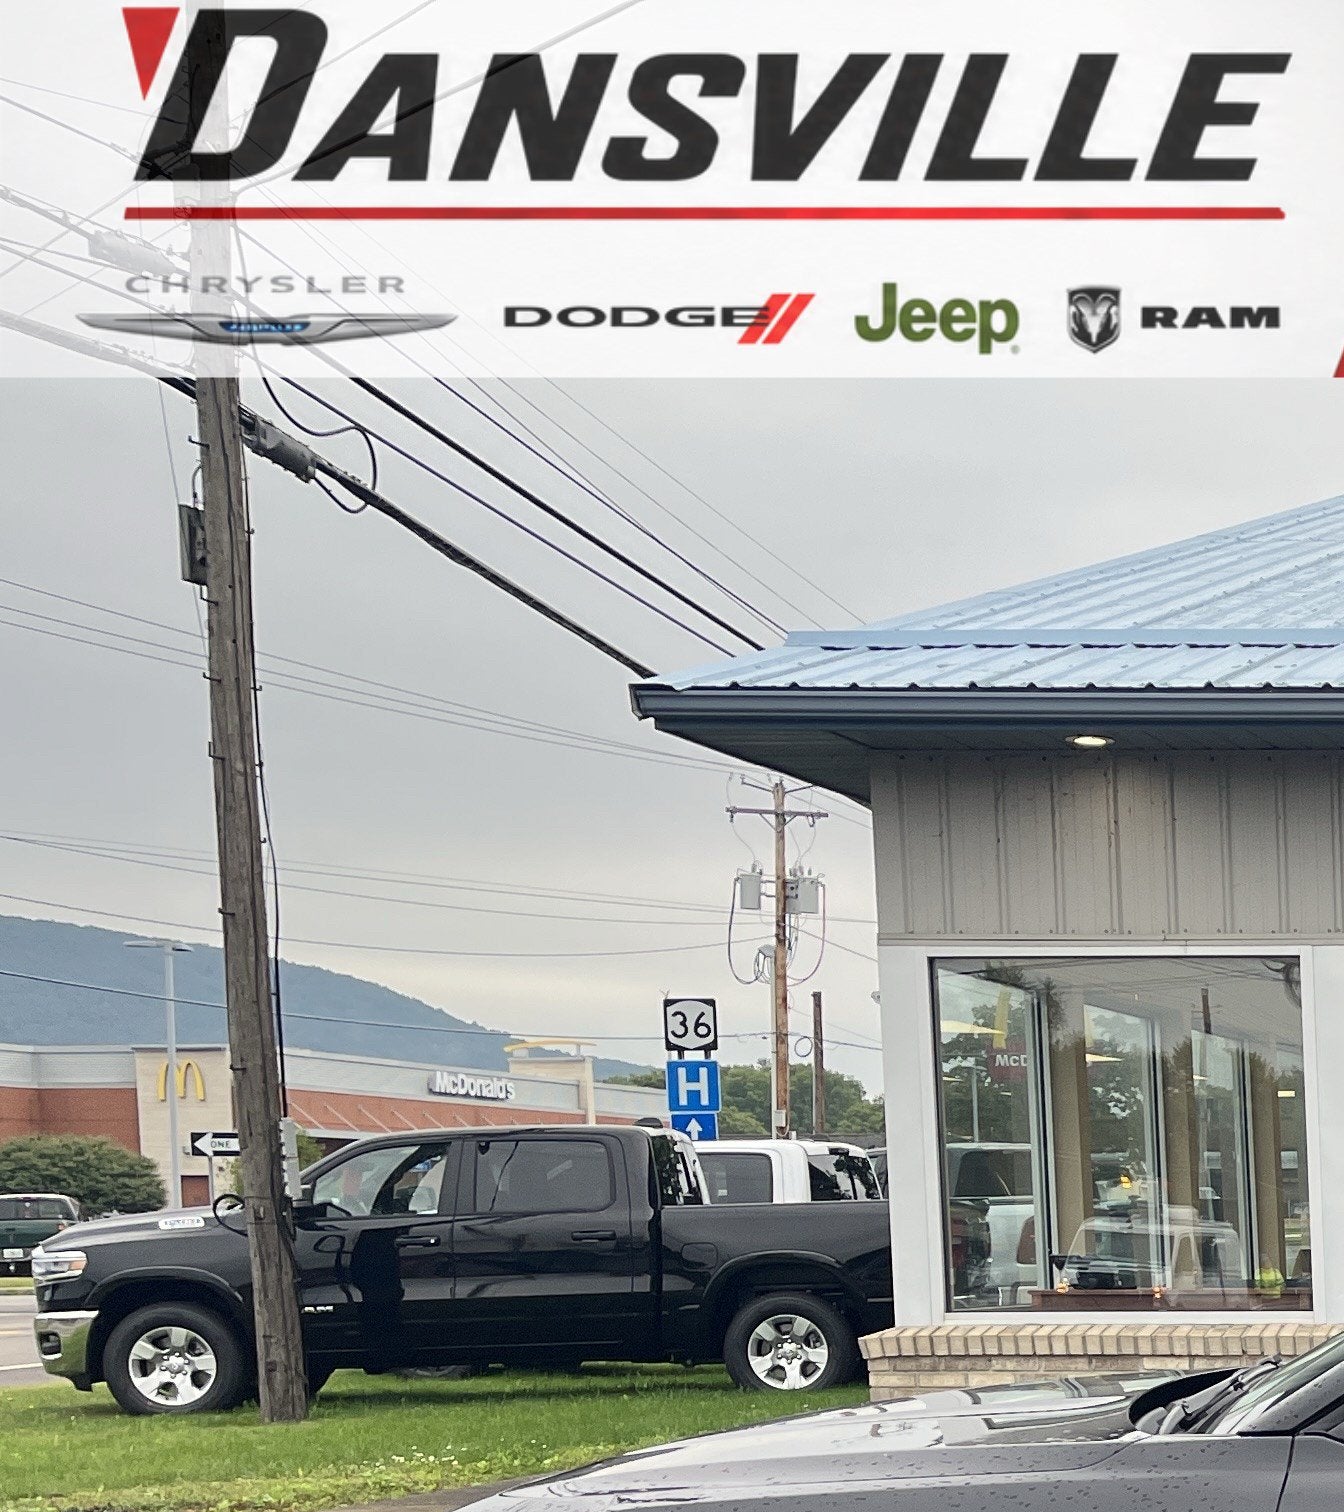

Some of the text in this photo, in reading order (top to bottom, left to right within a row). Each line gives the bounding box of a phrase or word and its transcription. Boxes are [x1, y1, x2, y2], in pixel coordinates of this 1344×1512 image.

[671, 1011, 711, 1038] 36
[677, 1067, 709, 1106] H
[210, 1140, 231, 1149] ONE
